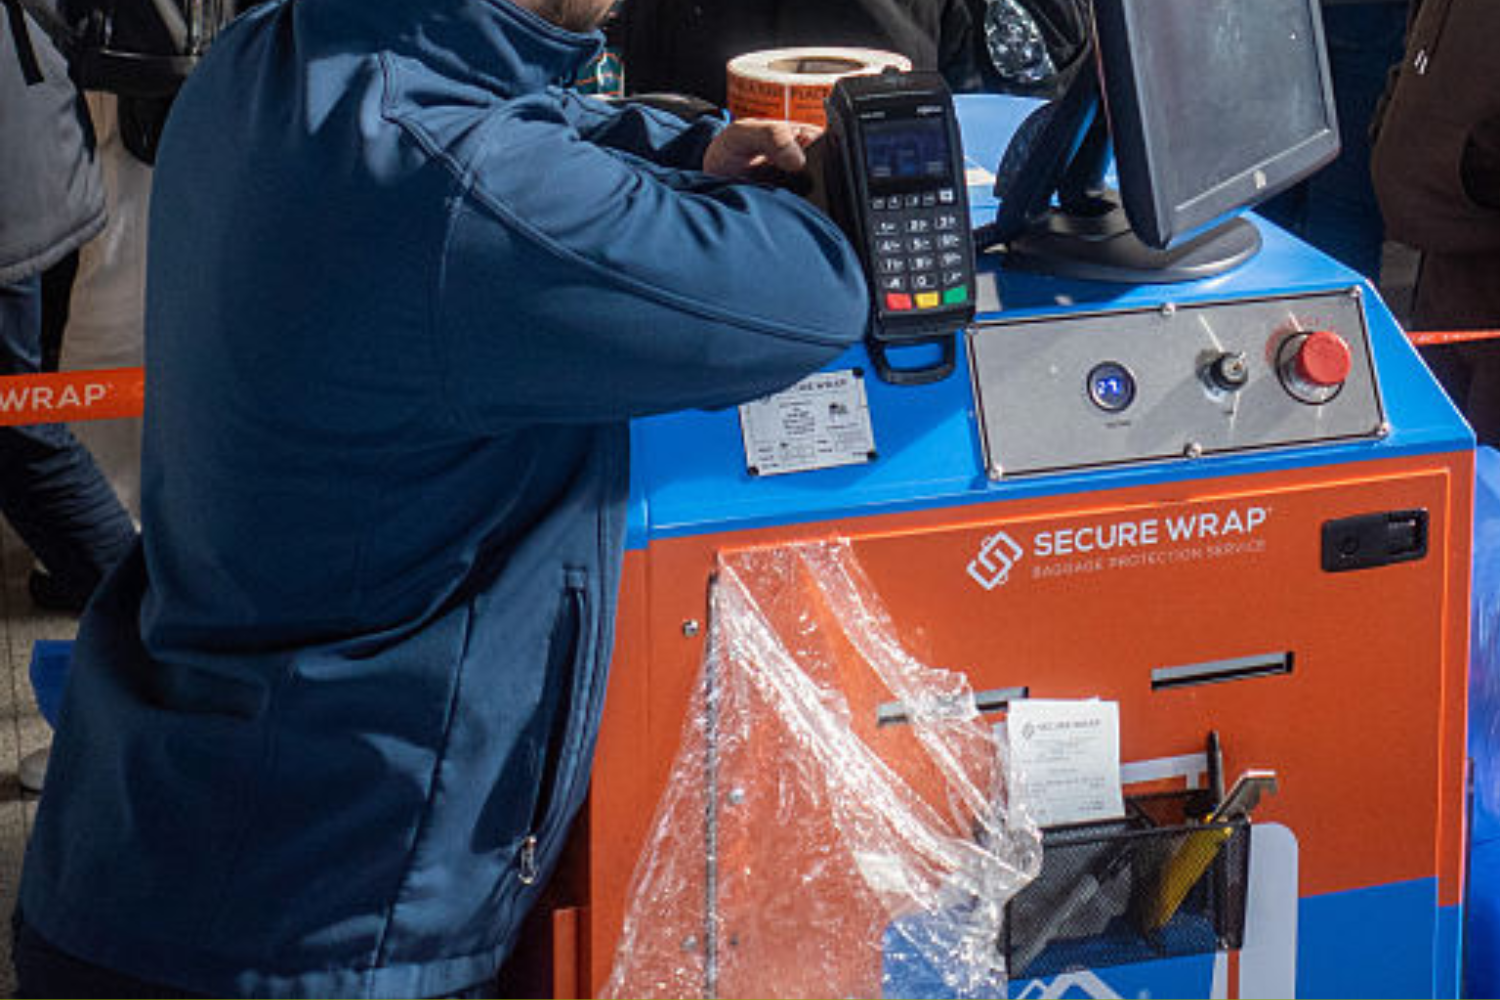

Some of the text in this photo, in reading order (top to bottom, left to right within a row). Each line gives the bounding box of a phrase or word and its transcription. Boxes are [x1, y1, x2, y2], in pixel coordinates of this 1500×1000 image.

[0, 383, 107, 412] WRAP
[1033, 507, 1266, 556] SECURE WRAP
[1032, 558, 1102, 579] BAGGAGE
[1108, 548, 1202, 569] PROTECTION
